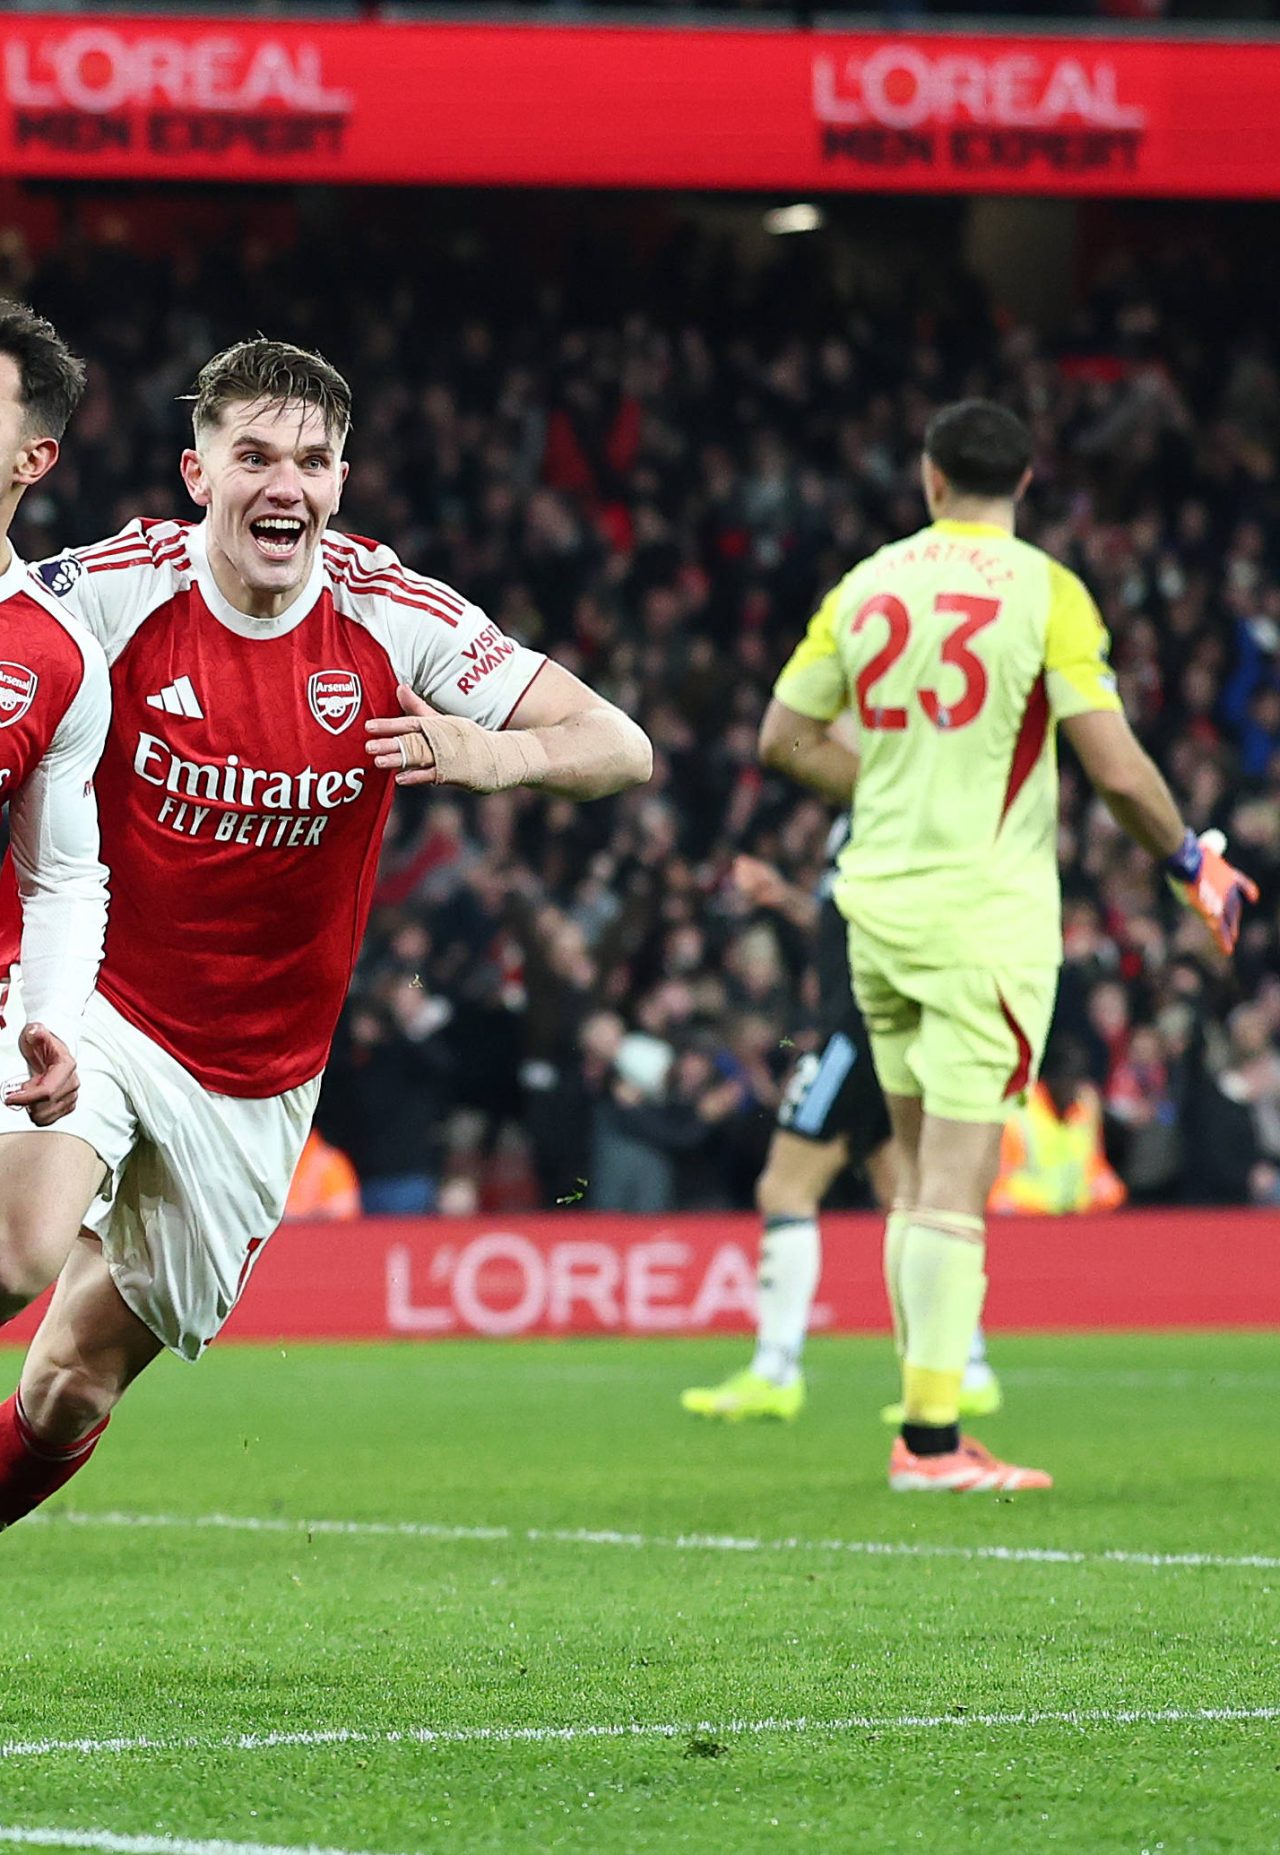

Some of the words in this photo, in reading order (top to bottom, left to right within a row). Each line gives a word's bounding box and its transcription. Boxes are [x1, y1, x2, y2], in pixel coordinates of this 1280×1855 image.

[316, 681, 354, 693] Arsenal
[457, 641, 514, 696] RWAN
[851, 593, 1002, 731] 23
[133, 731, 365, 810] Emirates
[157, 795, 210, 836] FLY
[214, 811, 329, 847] BETTER
[385, 1230, 835, 1336] L'ORÉA
